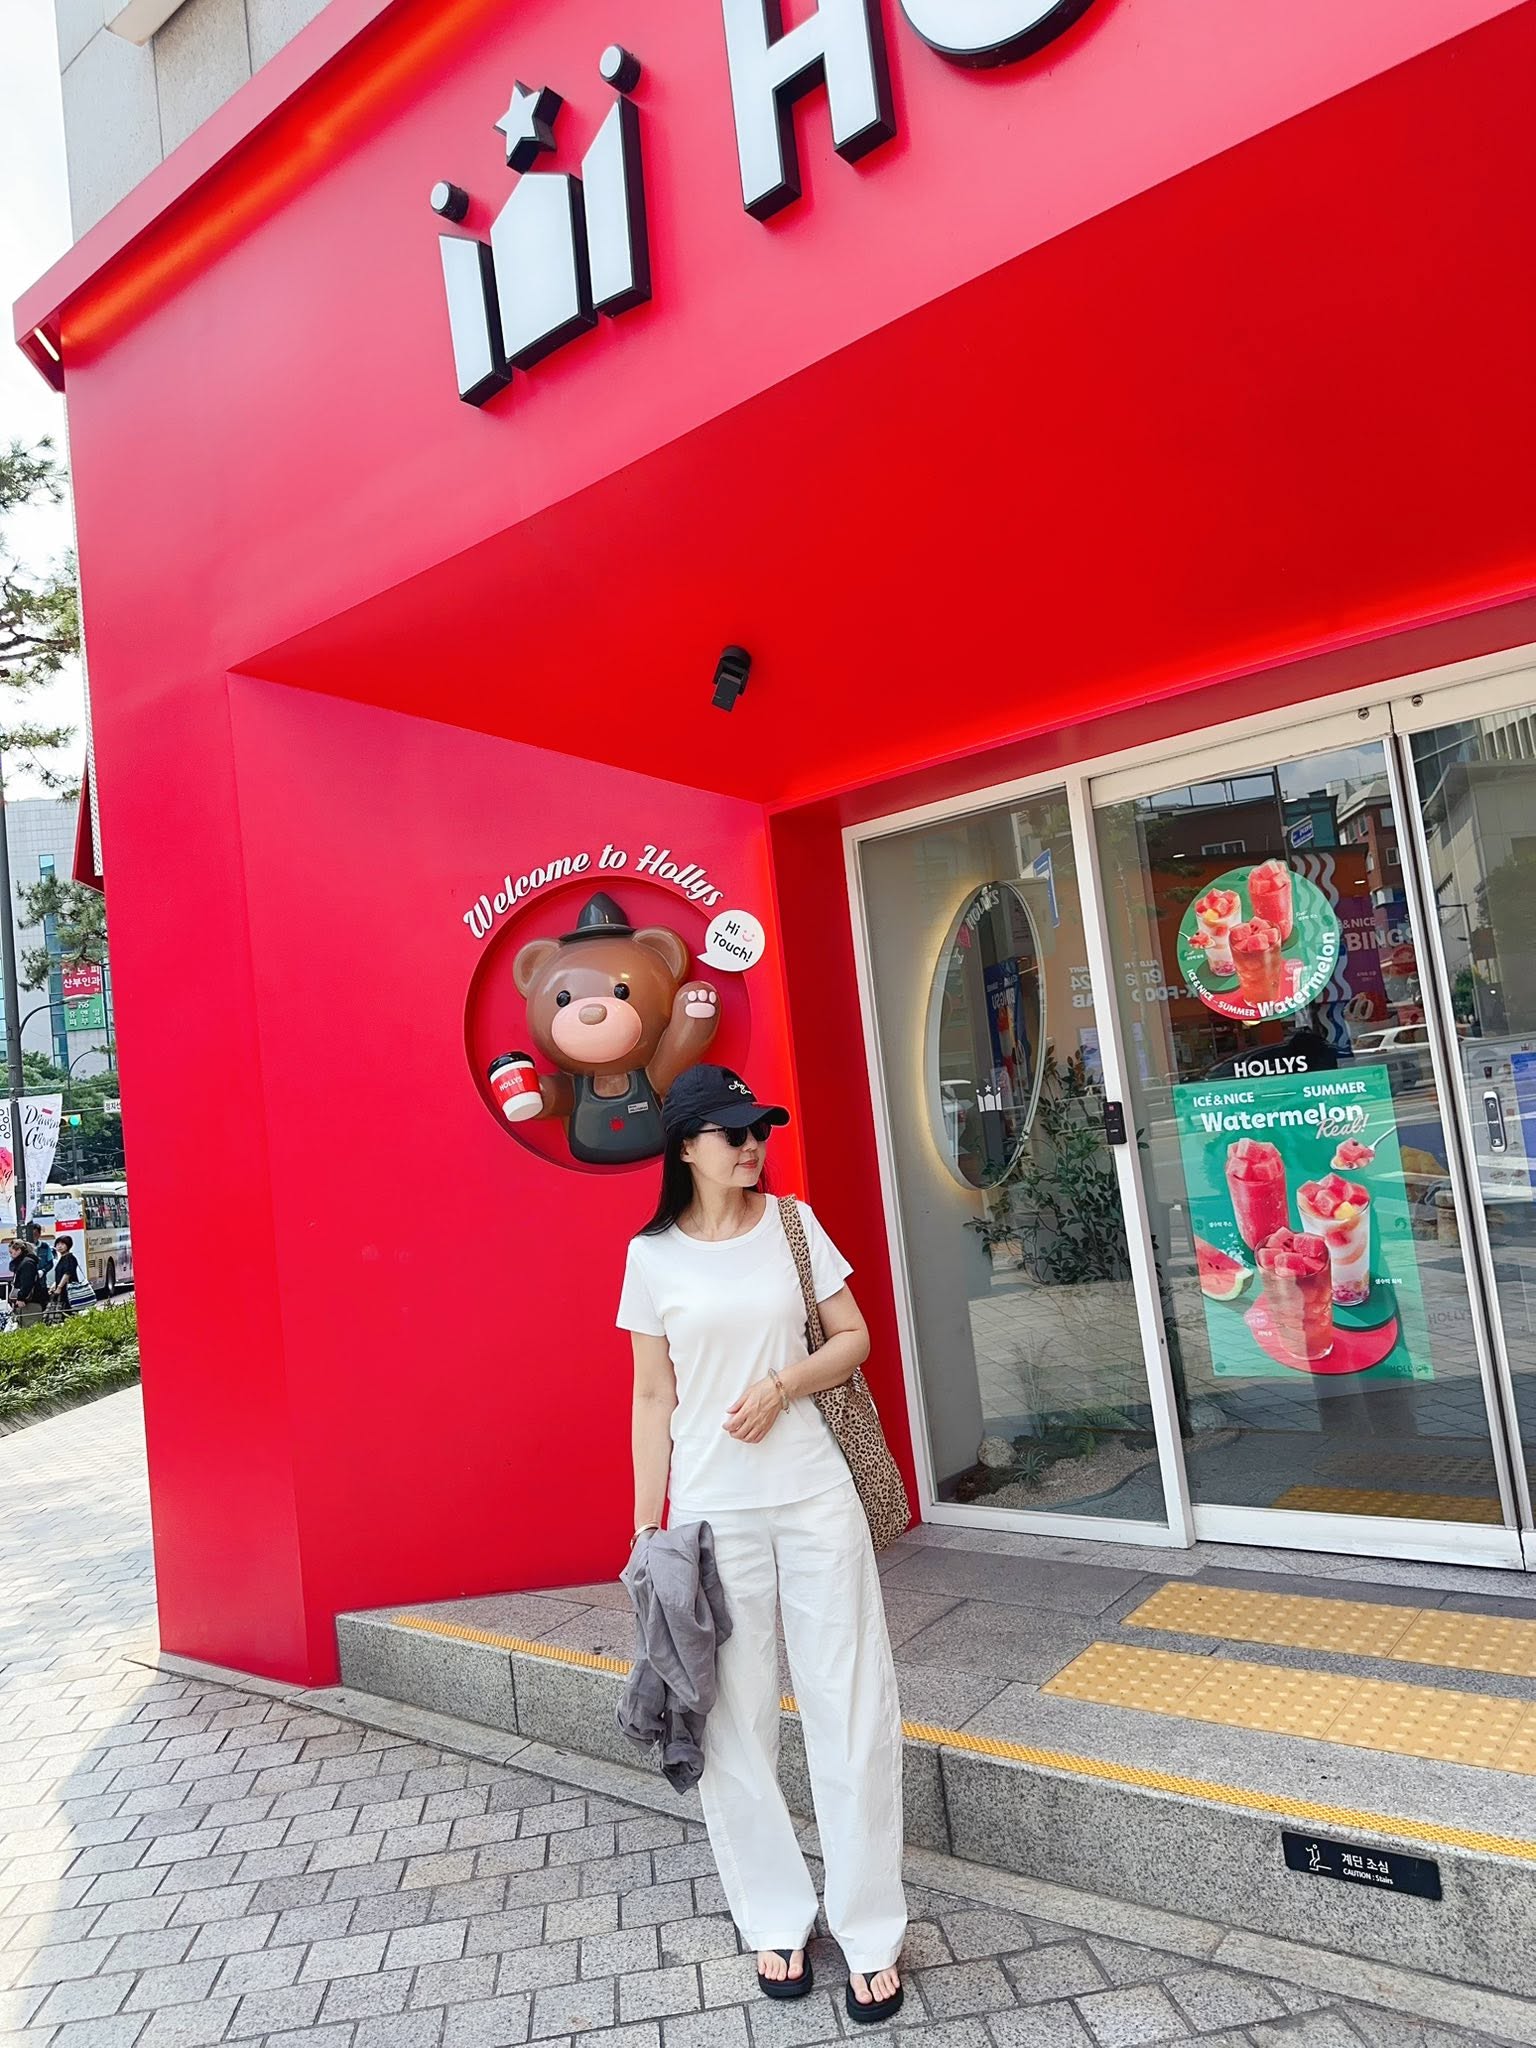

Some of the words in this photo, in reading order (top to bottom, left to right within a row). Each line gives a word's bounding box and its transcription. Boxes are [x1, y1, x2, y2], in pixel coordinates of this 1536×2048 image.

[462, 852, 591, 940] Welcome
[598, 843, 628, 870] to
[635, 844, 726, 908] Hollys
[724, 920, 741, 936] Hi
[712, 931, 753, 963] Touch!
[63, 976, 100, 988] 산부인과
[1256, 931, 1336, 1018] Watermelon
[1186, 968, 1214, 1001] ICE&NICE
[1217, 1001, 1257, 1017] SUMMER
[1233, 1055, 1309, 1079] HOLLYS
[499, 1076, 524, 1091] HOLLYS
[1193, 1092, 1255, 1108] ICE&NICE
[1303, 1082, 1367, 1098] SUMMER
[1200, 1102, 1365, 1133] Watermelon
[1315, 1113, 1370, 1140] Real!
[1341, 1853, 1363, 1868] 계단
[1366, 1858, 1389, 1874] 조심
[1343, 1868, 1372, 1880] CAUTION
[1375, 1874, 1394, 1885] Stairs
